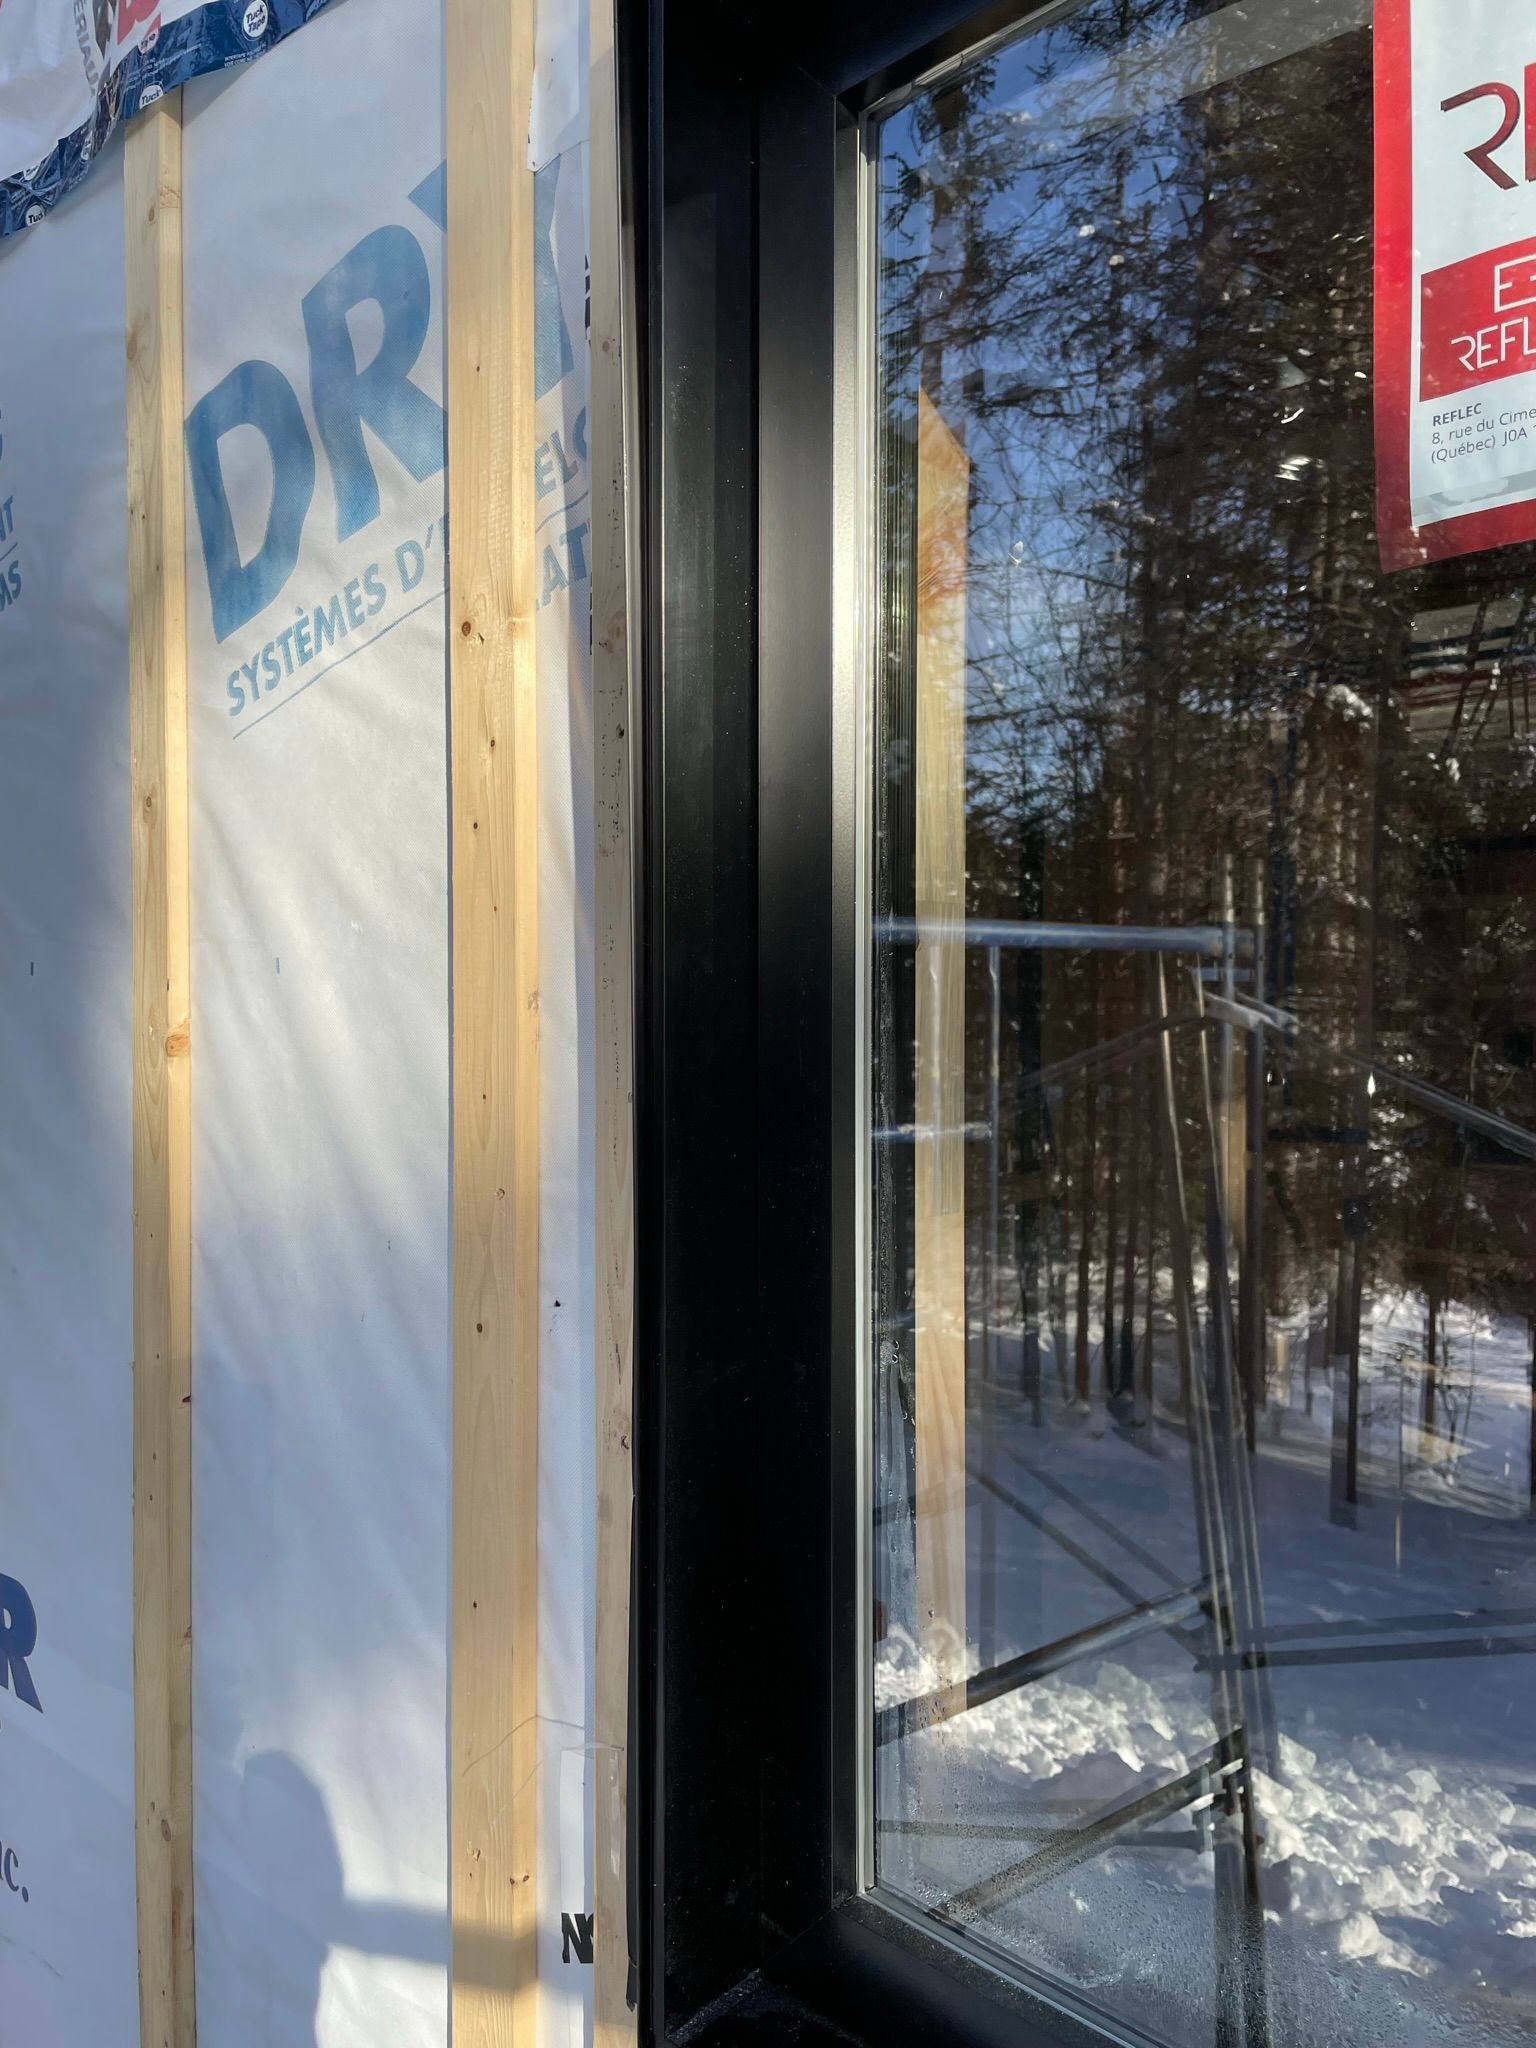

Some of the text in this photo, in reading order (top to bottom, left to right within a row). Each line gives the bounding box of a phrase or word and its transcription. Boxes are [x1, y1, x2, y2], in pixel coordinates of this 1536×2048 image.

[246, 4, 265, 23] Tuck
[248, 16, 266, 33] Tape
[1440, 62, 1536, 190] R
[28, 211, 44, 224] Tuc
[1432, 403, 1482, 427] REFLEC
[1432, 431, 1444, 445] 8,
[1449, 426, 1472, 440] rue
[1476, 419, 1495, 432] du
[1431, 435, 1496, 464] (Québec)
[227, 562, 387, 717] SYSTÈMES
